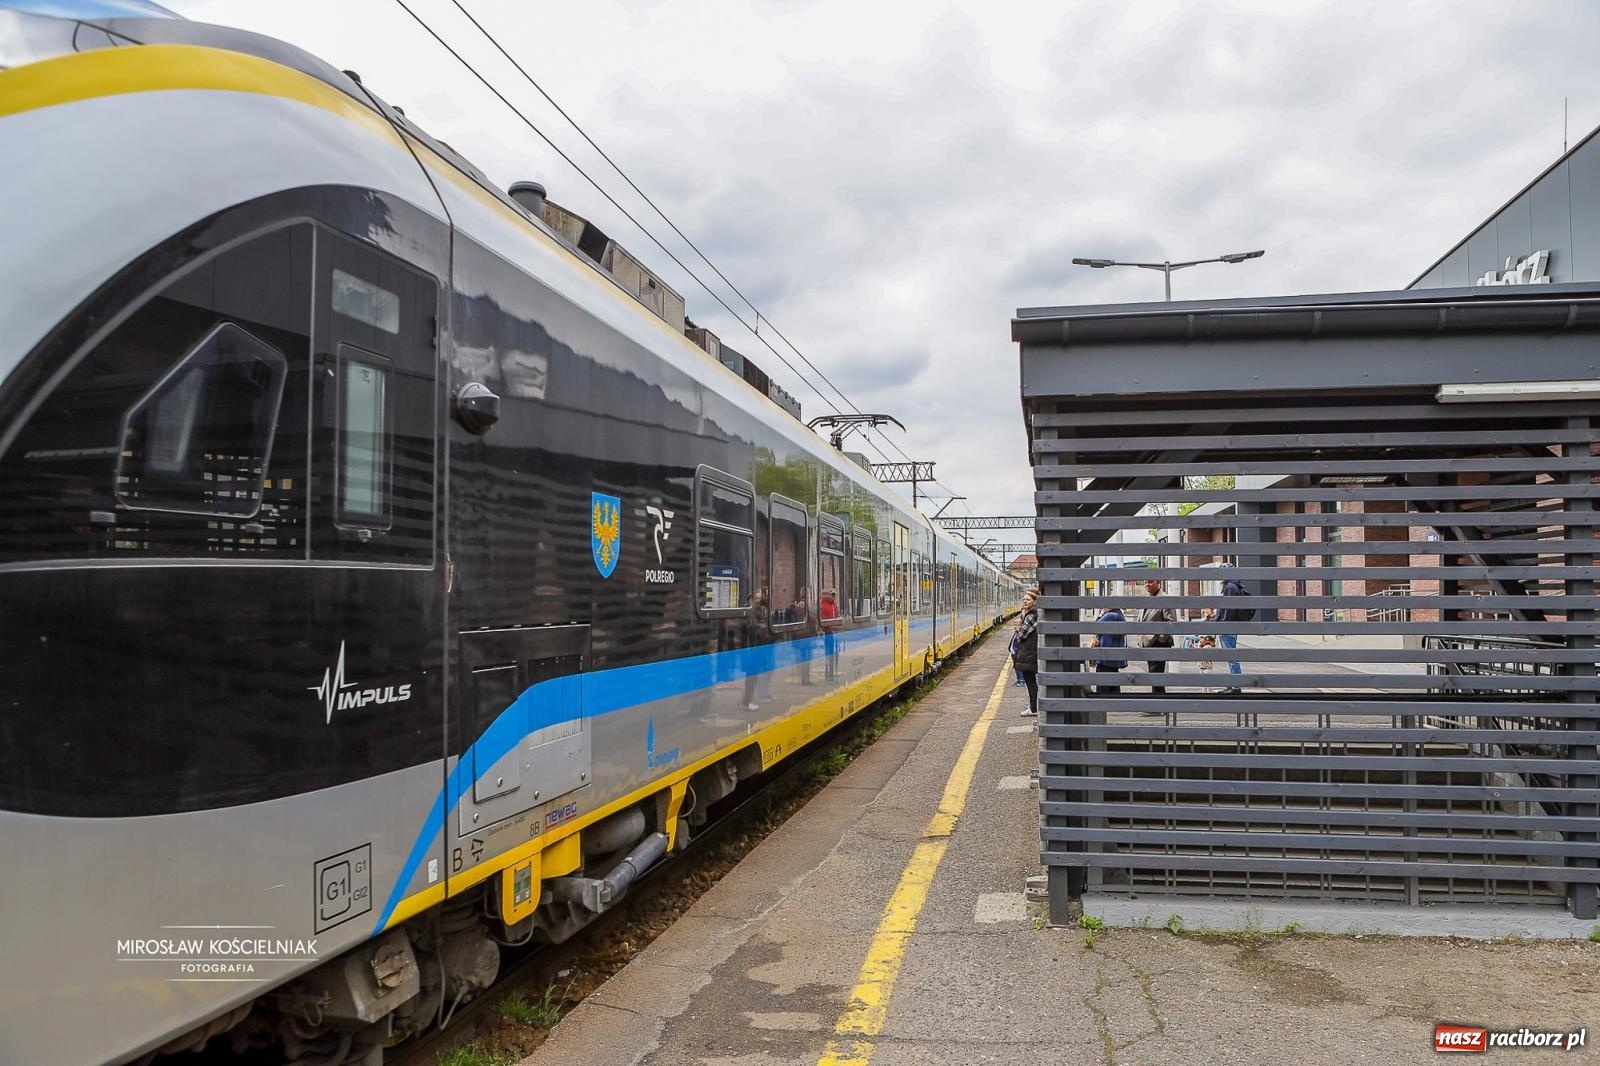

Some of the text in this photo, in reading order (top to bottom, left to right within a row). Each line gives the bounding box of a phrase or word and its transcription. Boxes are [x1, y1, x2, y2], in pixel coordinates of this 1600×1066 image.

[645, 569, 675, 584] POLREGIO
[337, 684, 412, 711] IMPULS
[355, 860, 366, 873] G1
[452, 847, 464, 873] B
[326, 877, 346, 901] G1
